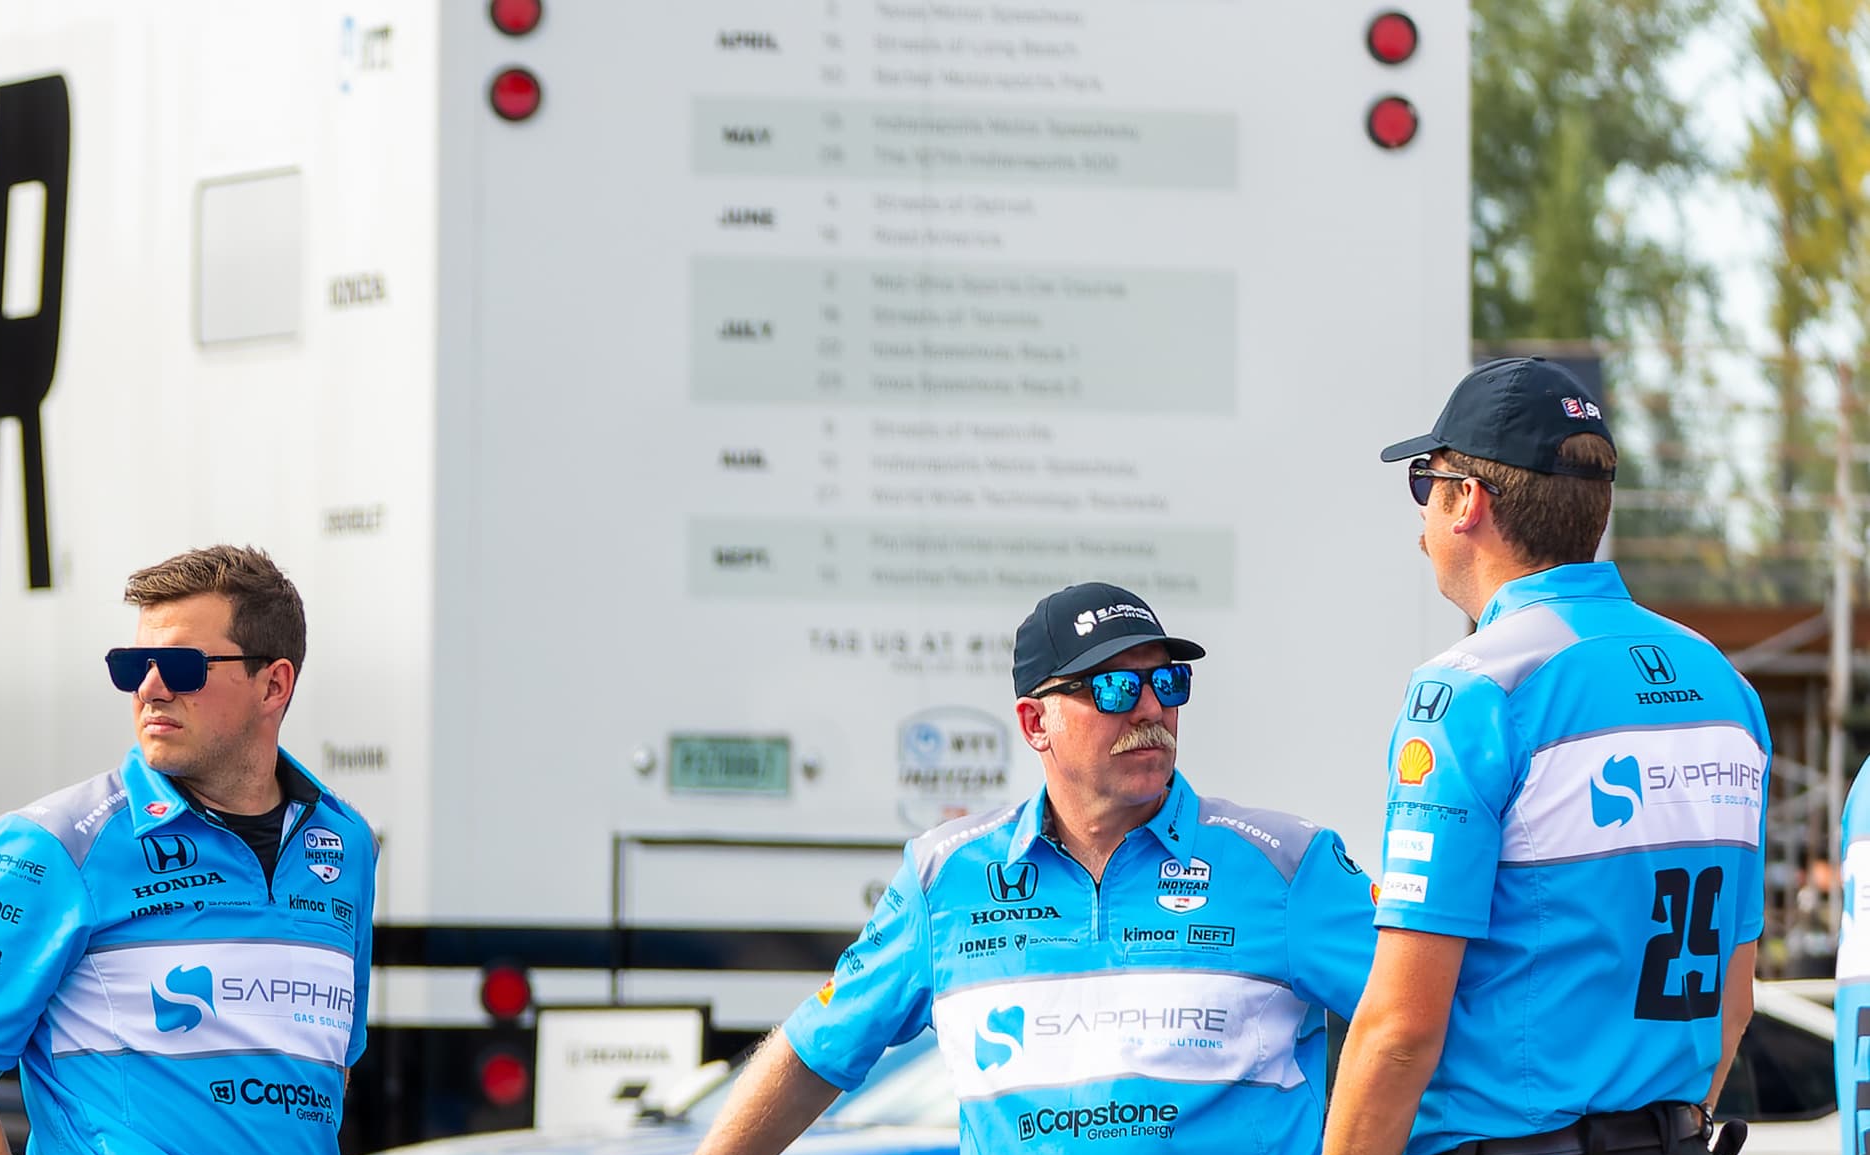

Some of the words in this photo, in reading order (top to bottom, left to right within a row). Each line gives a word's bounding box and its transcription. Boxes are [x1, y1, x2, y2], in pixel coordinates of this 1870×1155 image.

[1635, 688, 1704, 705] HONDA
[131, 871, 227, 899] HONDA
[1156, 879, 1210, 892] INDYCAR
[288, 894, 326, 913] kimoa
[970, 906, 1062, 926] HONDA
[1123, 926, 1176, 944] kimoa
[1192, 929, 1231, 943] NEFT
[957, 935, 1008, 956] JONES
[221, 977, 354, 1014] SAPPHIR
[293, 1013, 316, 1024] GAS
[319, 1014, 352, 1033] SOLUTIO
[1033, 1006, 1229, 1037] SAPPHIRE
[296, 1108, 324, 1123] Green
[1036, 1100, 1179, 1139] Capstone
[1087, 1127, 1127, 1141] Green
[1130, 1123, 1176, 1139] Energy
